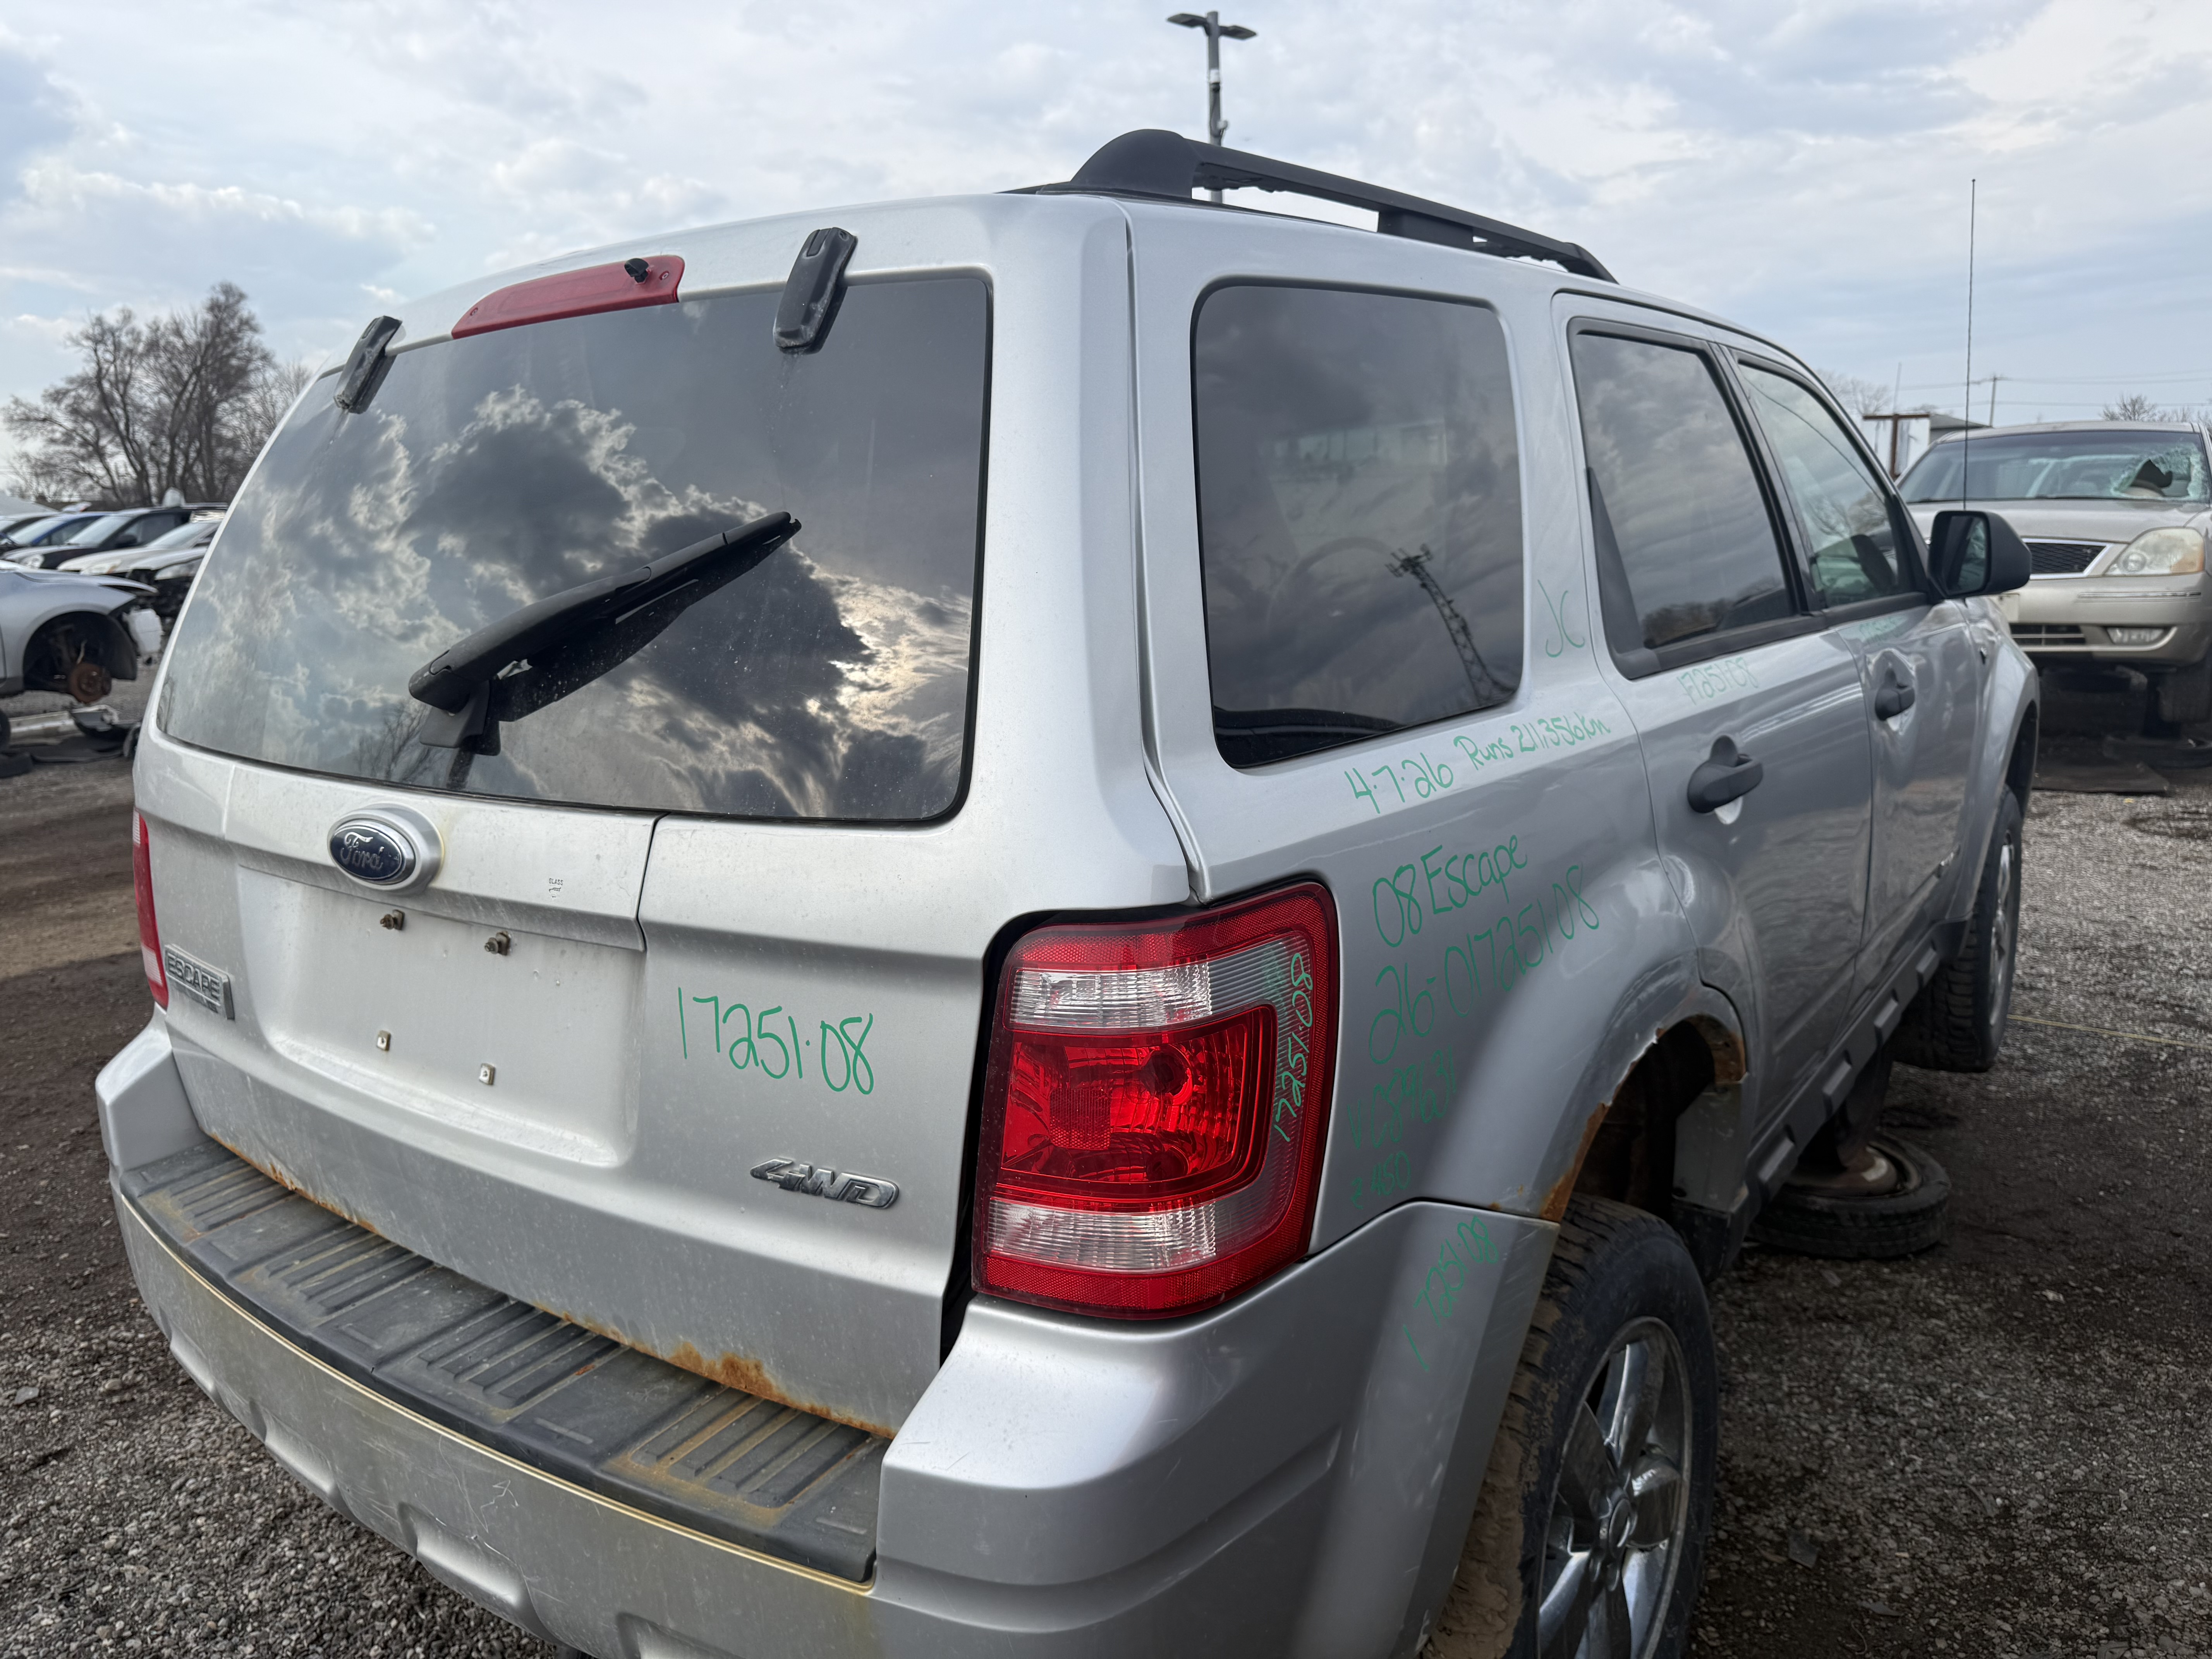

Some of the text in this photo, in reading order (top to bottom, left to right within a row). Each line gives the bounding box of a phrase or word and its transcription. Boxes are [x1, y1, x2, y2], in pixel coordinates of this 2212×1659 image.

[1453, 735, 1514, 771] Runs
[340, 831, 384, 870] Ford
[168, 953, 221, 1002] ESCAPE
[750, 1158, 900, 1209] 4WD
